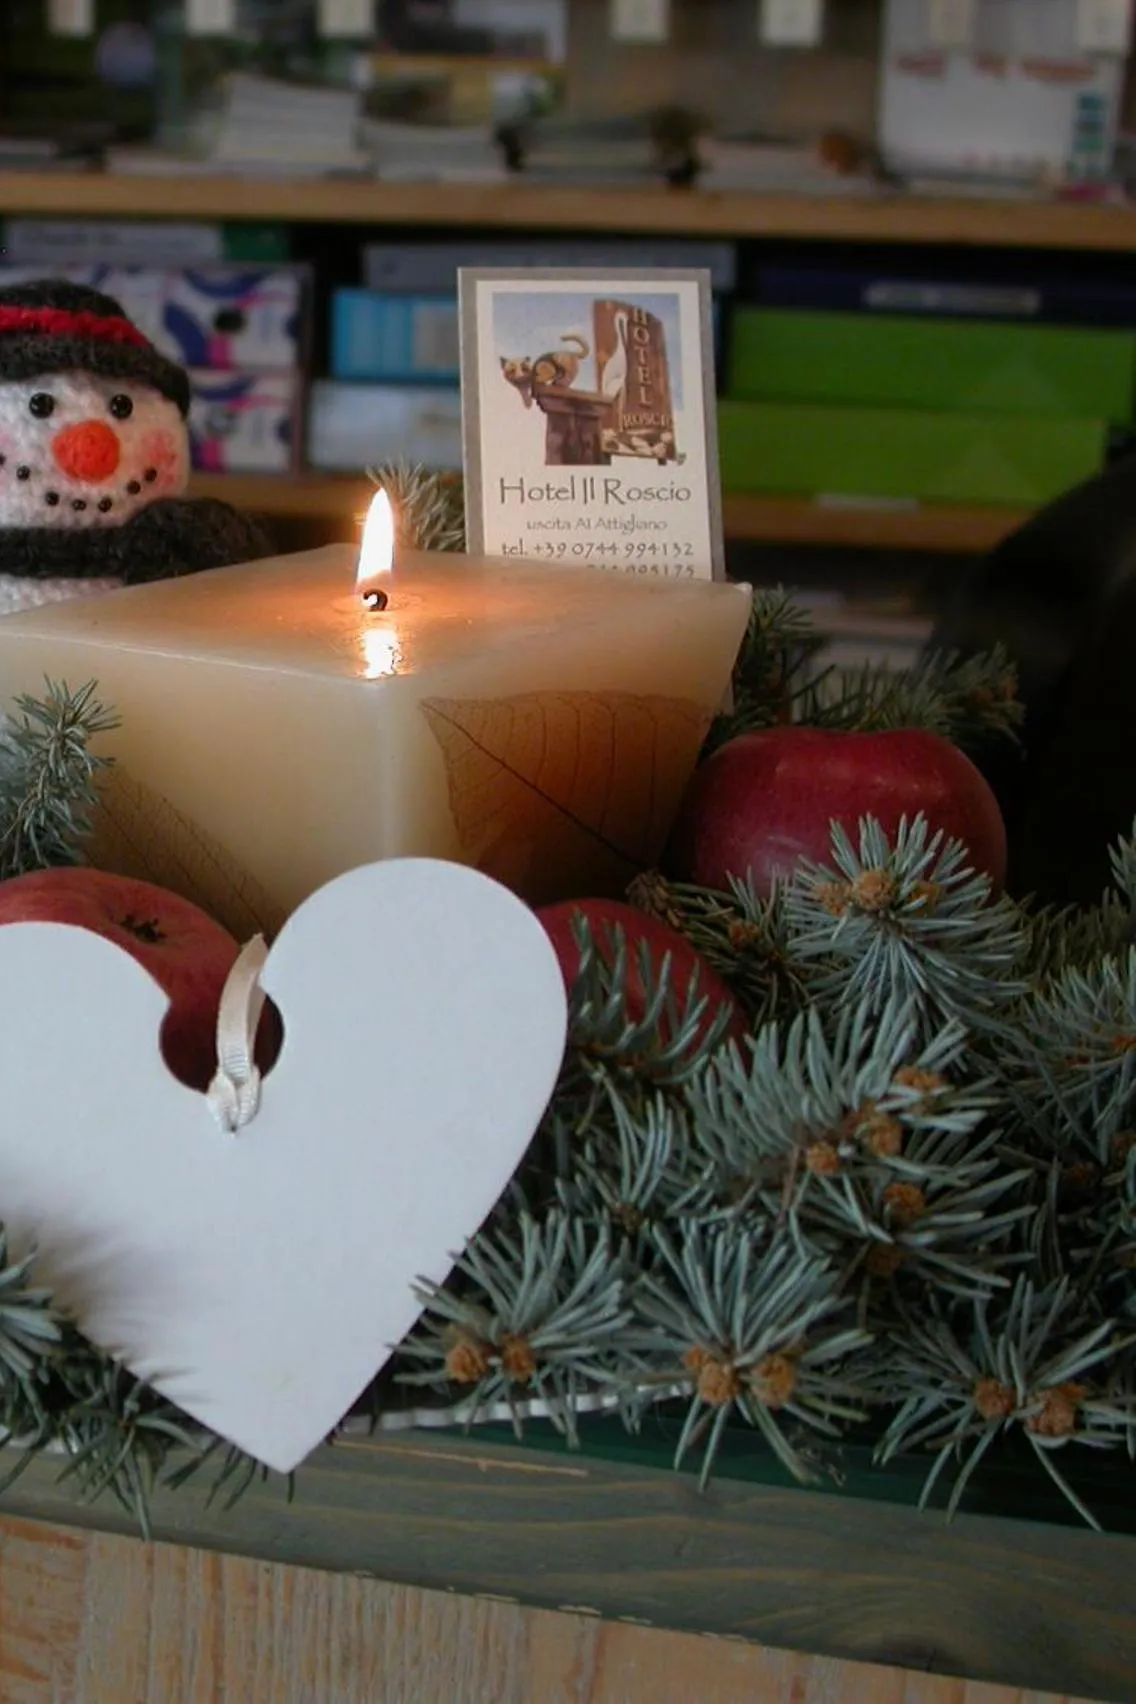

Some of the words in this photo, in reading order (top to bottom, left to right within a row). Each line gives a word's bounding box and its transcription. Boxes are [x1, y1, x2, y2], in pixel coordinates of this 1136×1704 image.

[633, 307, 652, 404] HOTEL
[500, 475, 575, 505] Hotel
[604, 477, 692, 505] Roscio
[526, 516, 571, 531] uscita
[595, 513, 668, 535] Attigliano
[501, 538, 528, 557] tel.
[533, 541, 567, 559] +39
[571, 541, 618, 559] 0744
[624, 541, 695, 559] 994132
